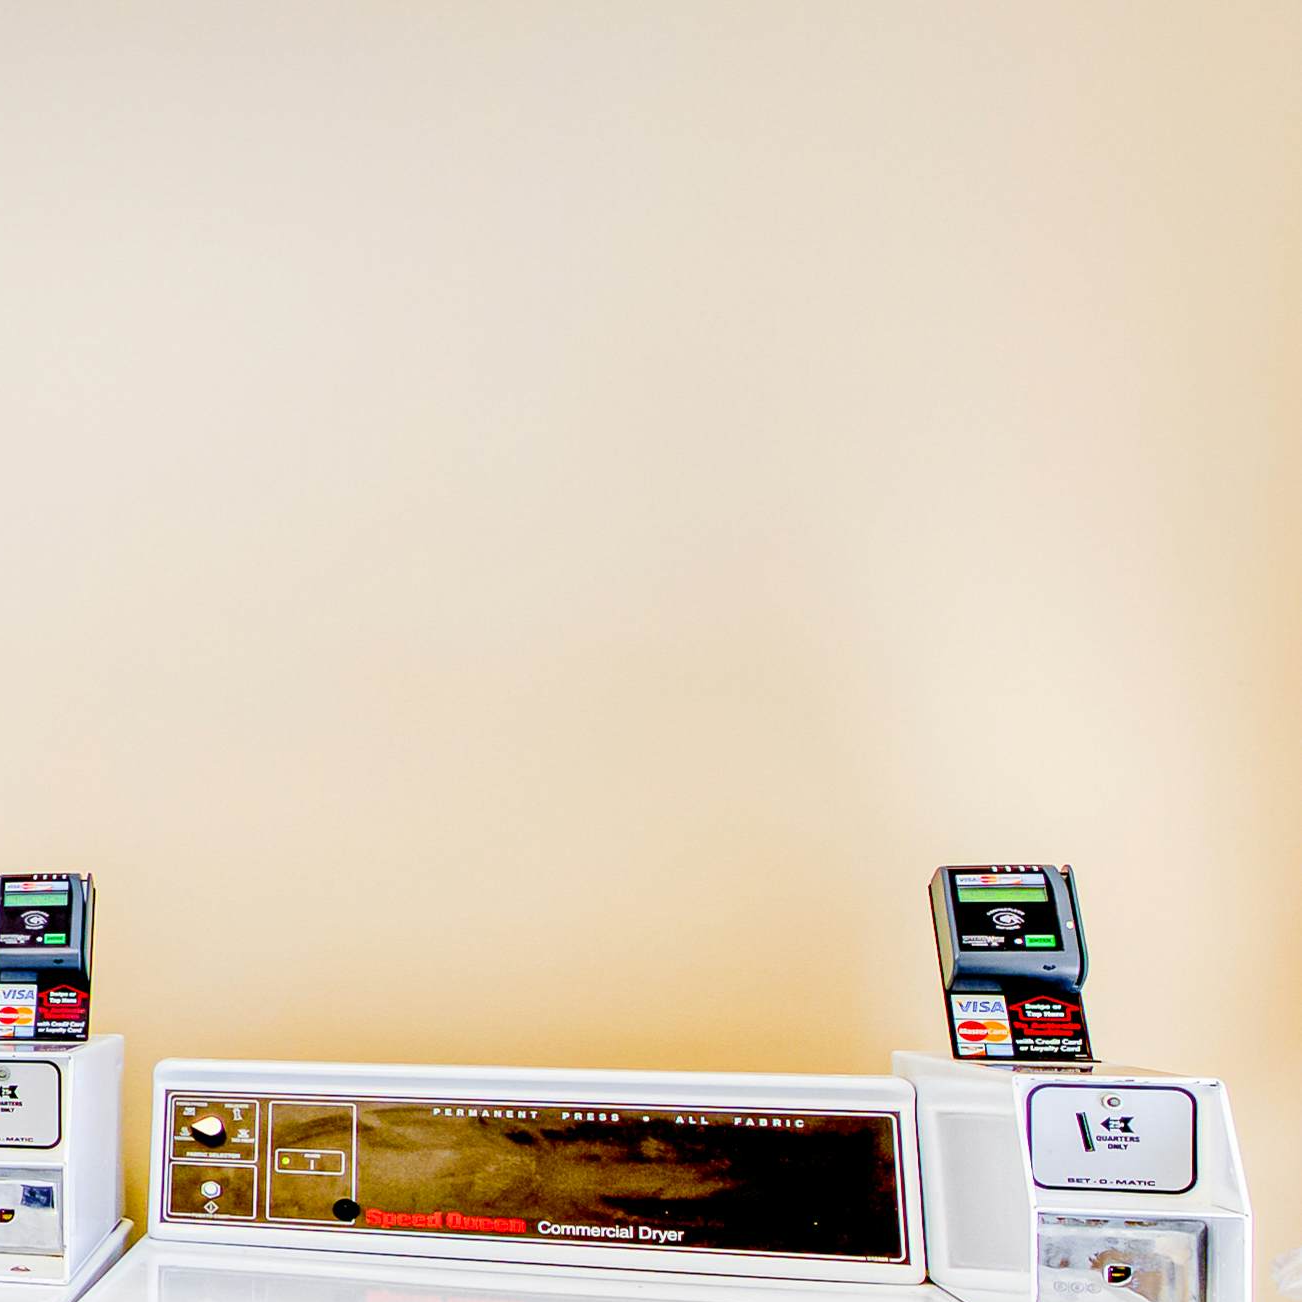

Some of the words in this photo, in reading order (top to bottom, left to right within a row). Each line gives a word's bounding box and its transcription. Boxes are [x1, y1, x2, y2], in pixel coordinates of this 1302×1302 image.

[1, 989, 34, 1000] VISA
[957, 1000, 1004, 1013] VISA
[1030, 1045, 1059, 1053] Loyalty
[432, 1107, 538, 1119] PERMANENT
[561, 1111, 620, 1122] PRESS
[675, 1115, 709, 1125] ALL
[734, 1117, 805, 1128] FABRIC
[1095, 1135, 1140, 1143] QUARTERS
[365, 1208, 443, 1230] Speed
[445, 1211, 527, 1234] Queen
[537, 1220, 634, 1240] Commercial
[638, 1226, 685, 1244] Dryer
